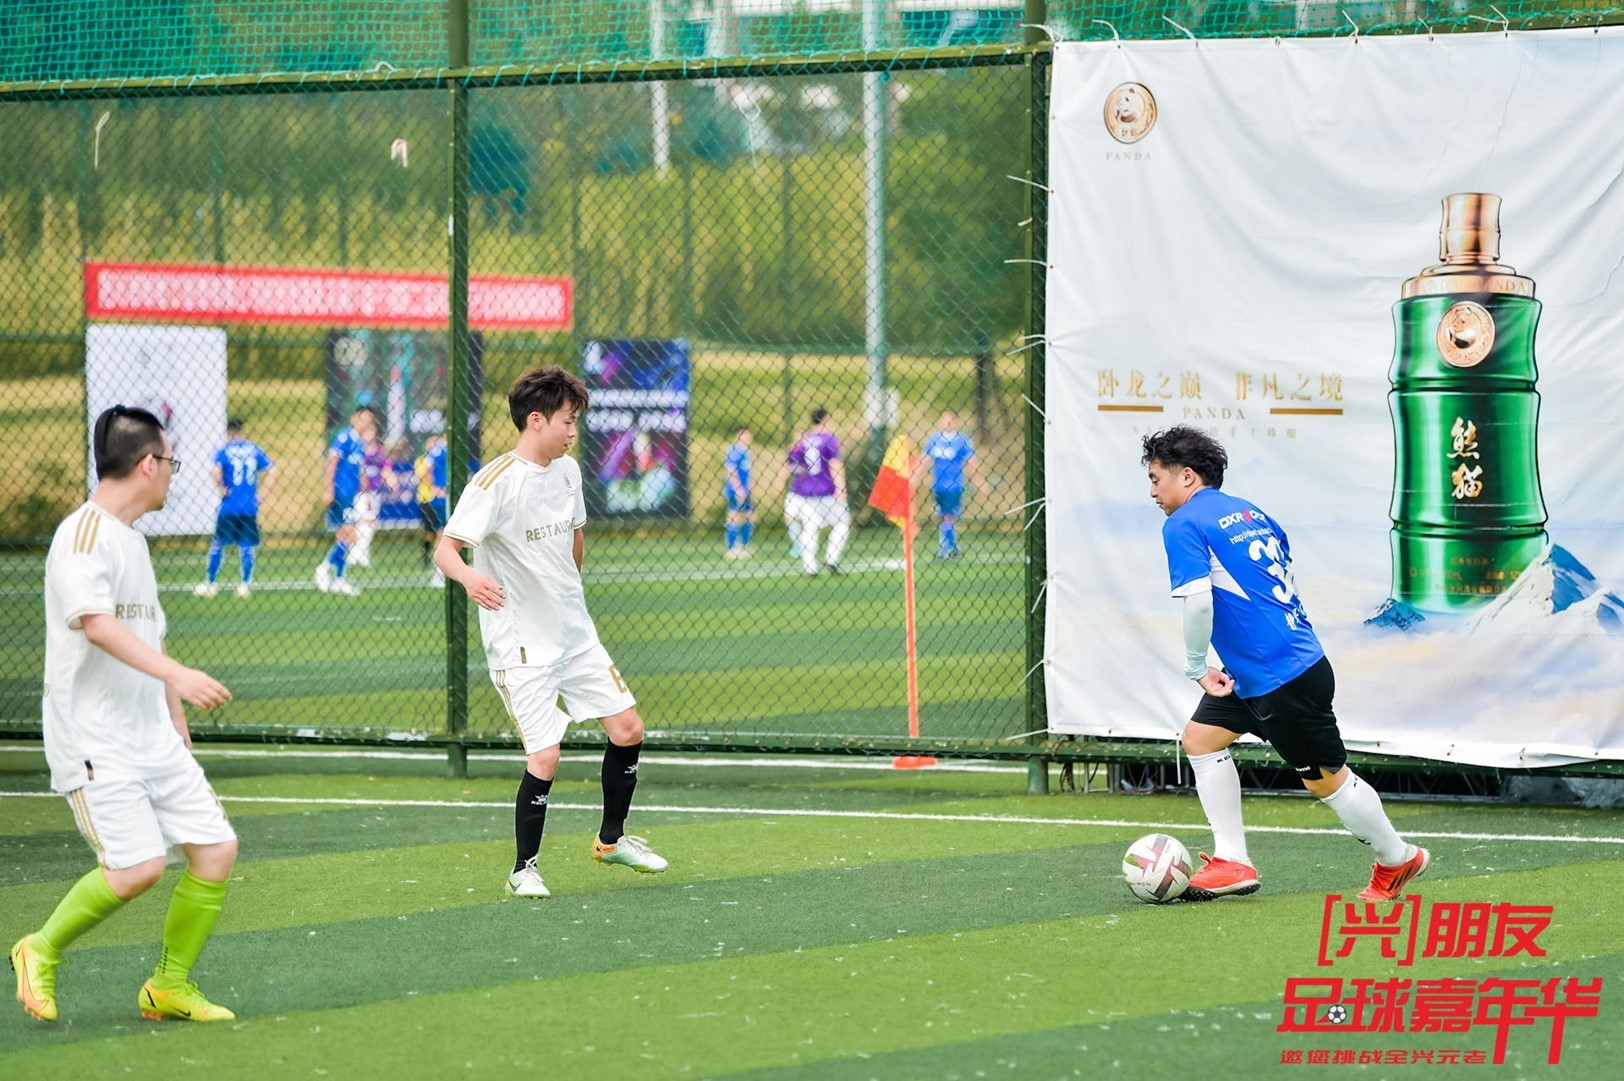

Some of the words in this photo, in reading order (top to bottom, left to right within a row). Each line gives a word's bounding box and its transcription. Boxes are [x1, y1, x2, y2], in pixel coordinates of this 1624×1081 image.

[1106, 151, 1152, 161] PANDA
[1097, 368, 1202, 400] 卧龙之巅
[1235, 371, 1343, 401] 非凡之境
[1183, 407, 1246, 420] PANDA
[1446, 416, 1483, 499] 熊猫
